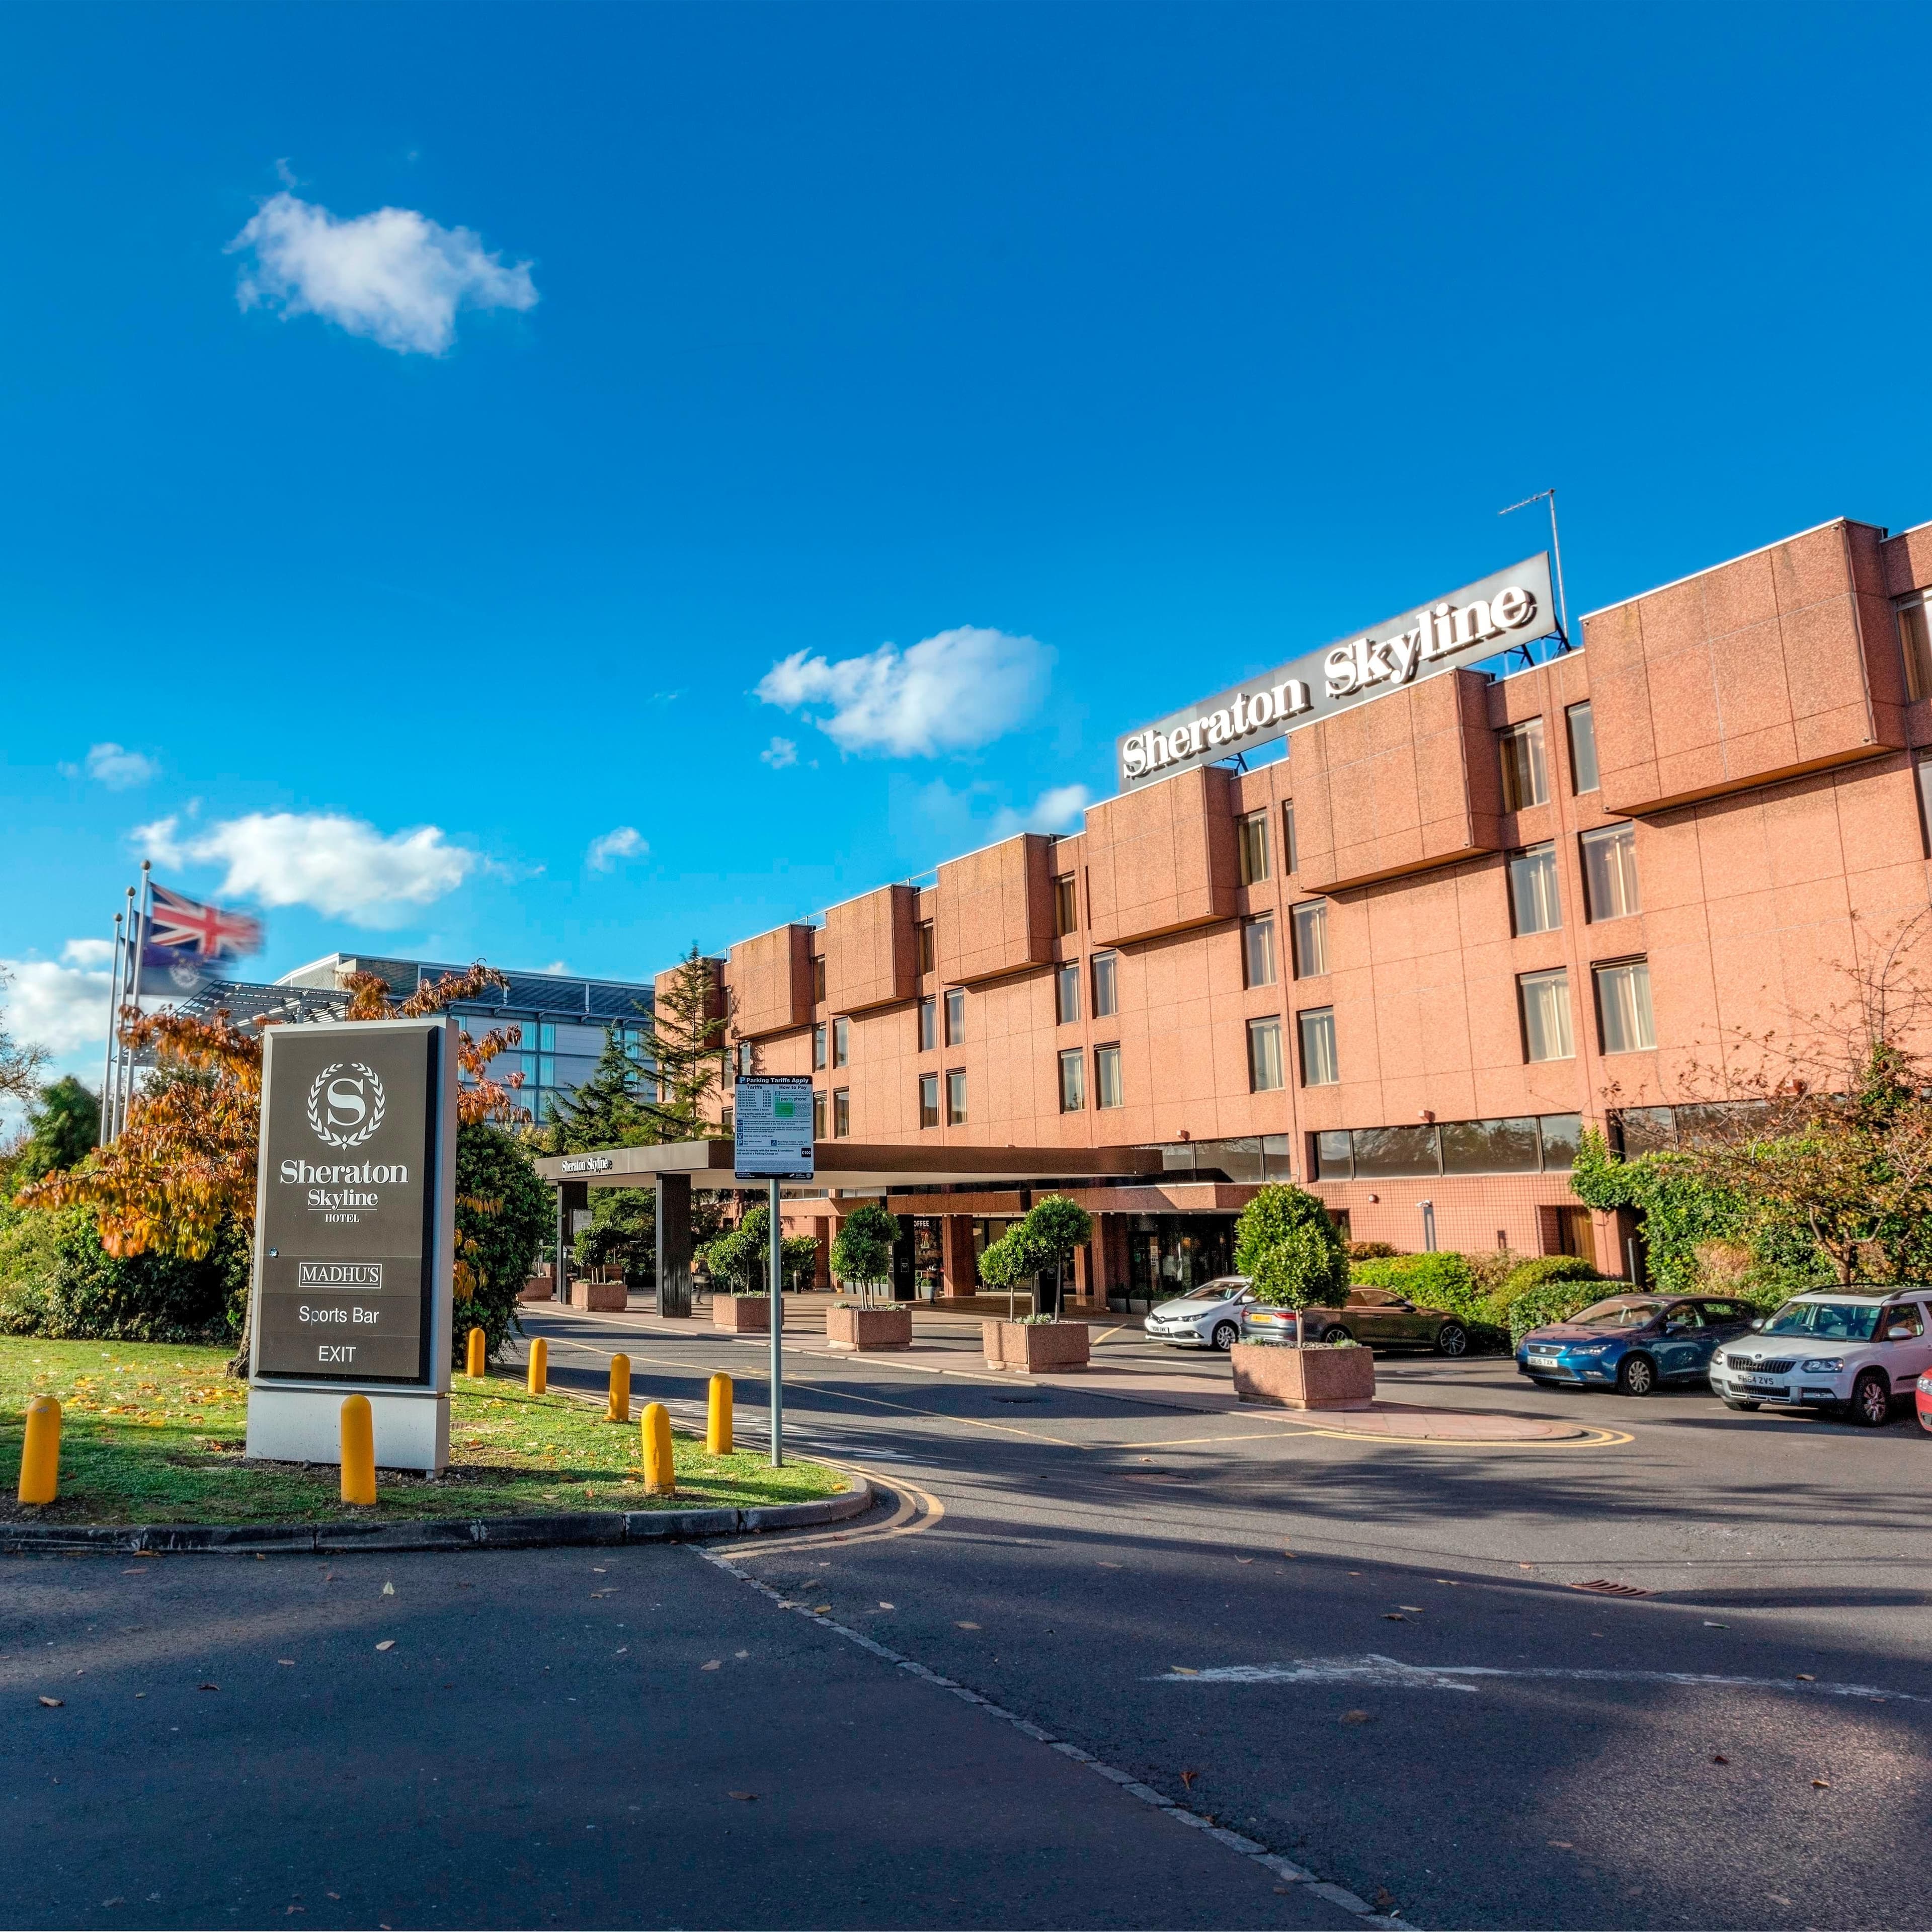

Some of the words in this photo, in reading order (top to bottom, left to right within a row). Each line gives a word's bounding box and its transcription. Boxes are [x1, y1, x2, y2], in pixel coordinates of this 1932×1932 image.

[1123, 679, 1307, 779] Sheraton
[1324, 586, 1533, 698] Skyline
[327, 1078, 366, 1126] S
[280, 1159, 409, 1184] Sheraton
[562, 1160, 586, 1172] Sheraton
[587, 1157, 608, 1172] Skyline
[307, 1189, 378, 1210] Skyline
[325, 1214, 360, 1223] HOTEL
[301, 1266, 379, 1282] MADHU'S
[299, 1306, 347, 1326] Sports
[353, 1307, 379, 1324] Bar
[318, 1345, 357, 1362] EXIT
[1737, 1375, 1756, 1384] FH64
[1758, 1377, 1774, 1385] ZVS
